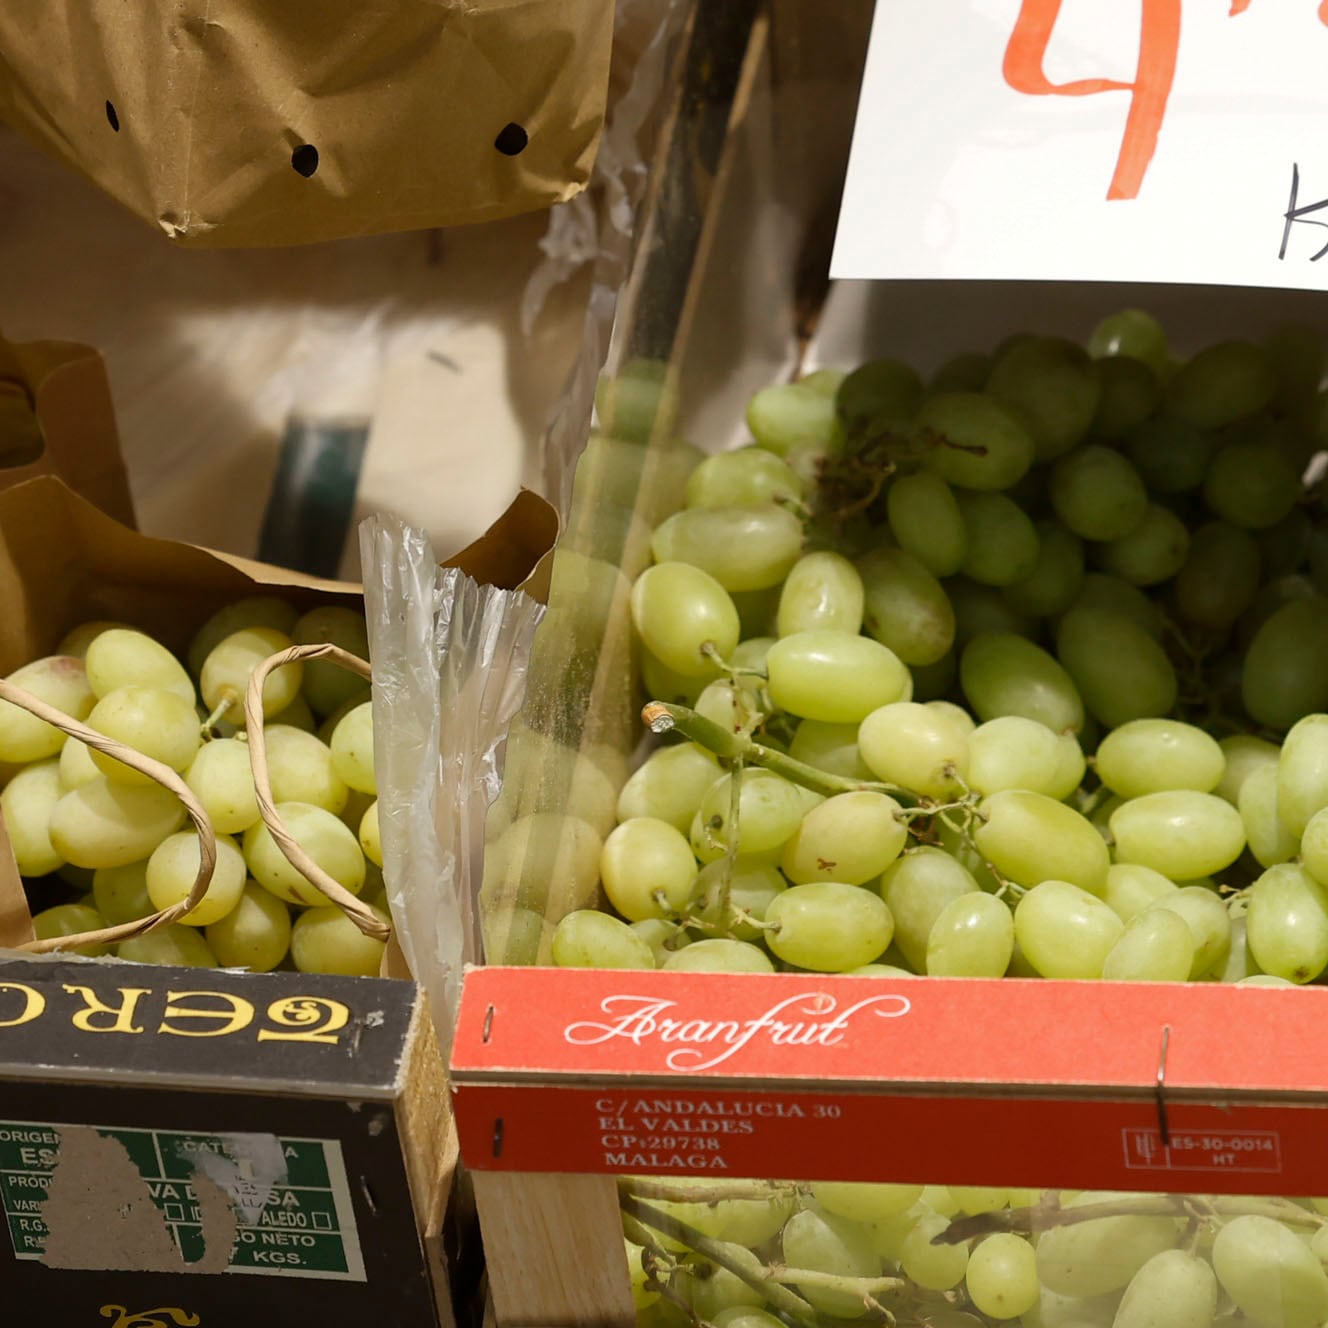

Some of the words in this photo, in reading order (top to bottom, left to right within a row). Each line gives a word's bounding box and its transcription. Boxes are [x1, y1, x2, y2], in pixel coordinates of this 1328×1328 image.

[563, 992, 912, 1072] Aranfrut
[812, 1103, 842, 1119] 30
[598, 1117, 635, 1132] EL
[640, 1117, 755, 1134] VALDES
[604, 1152, 729, 1169] MALAGA
[262, 1232, 316, 1248] NETO
[252, 1249, 308, 1265] KGS.
